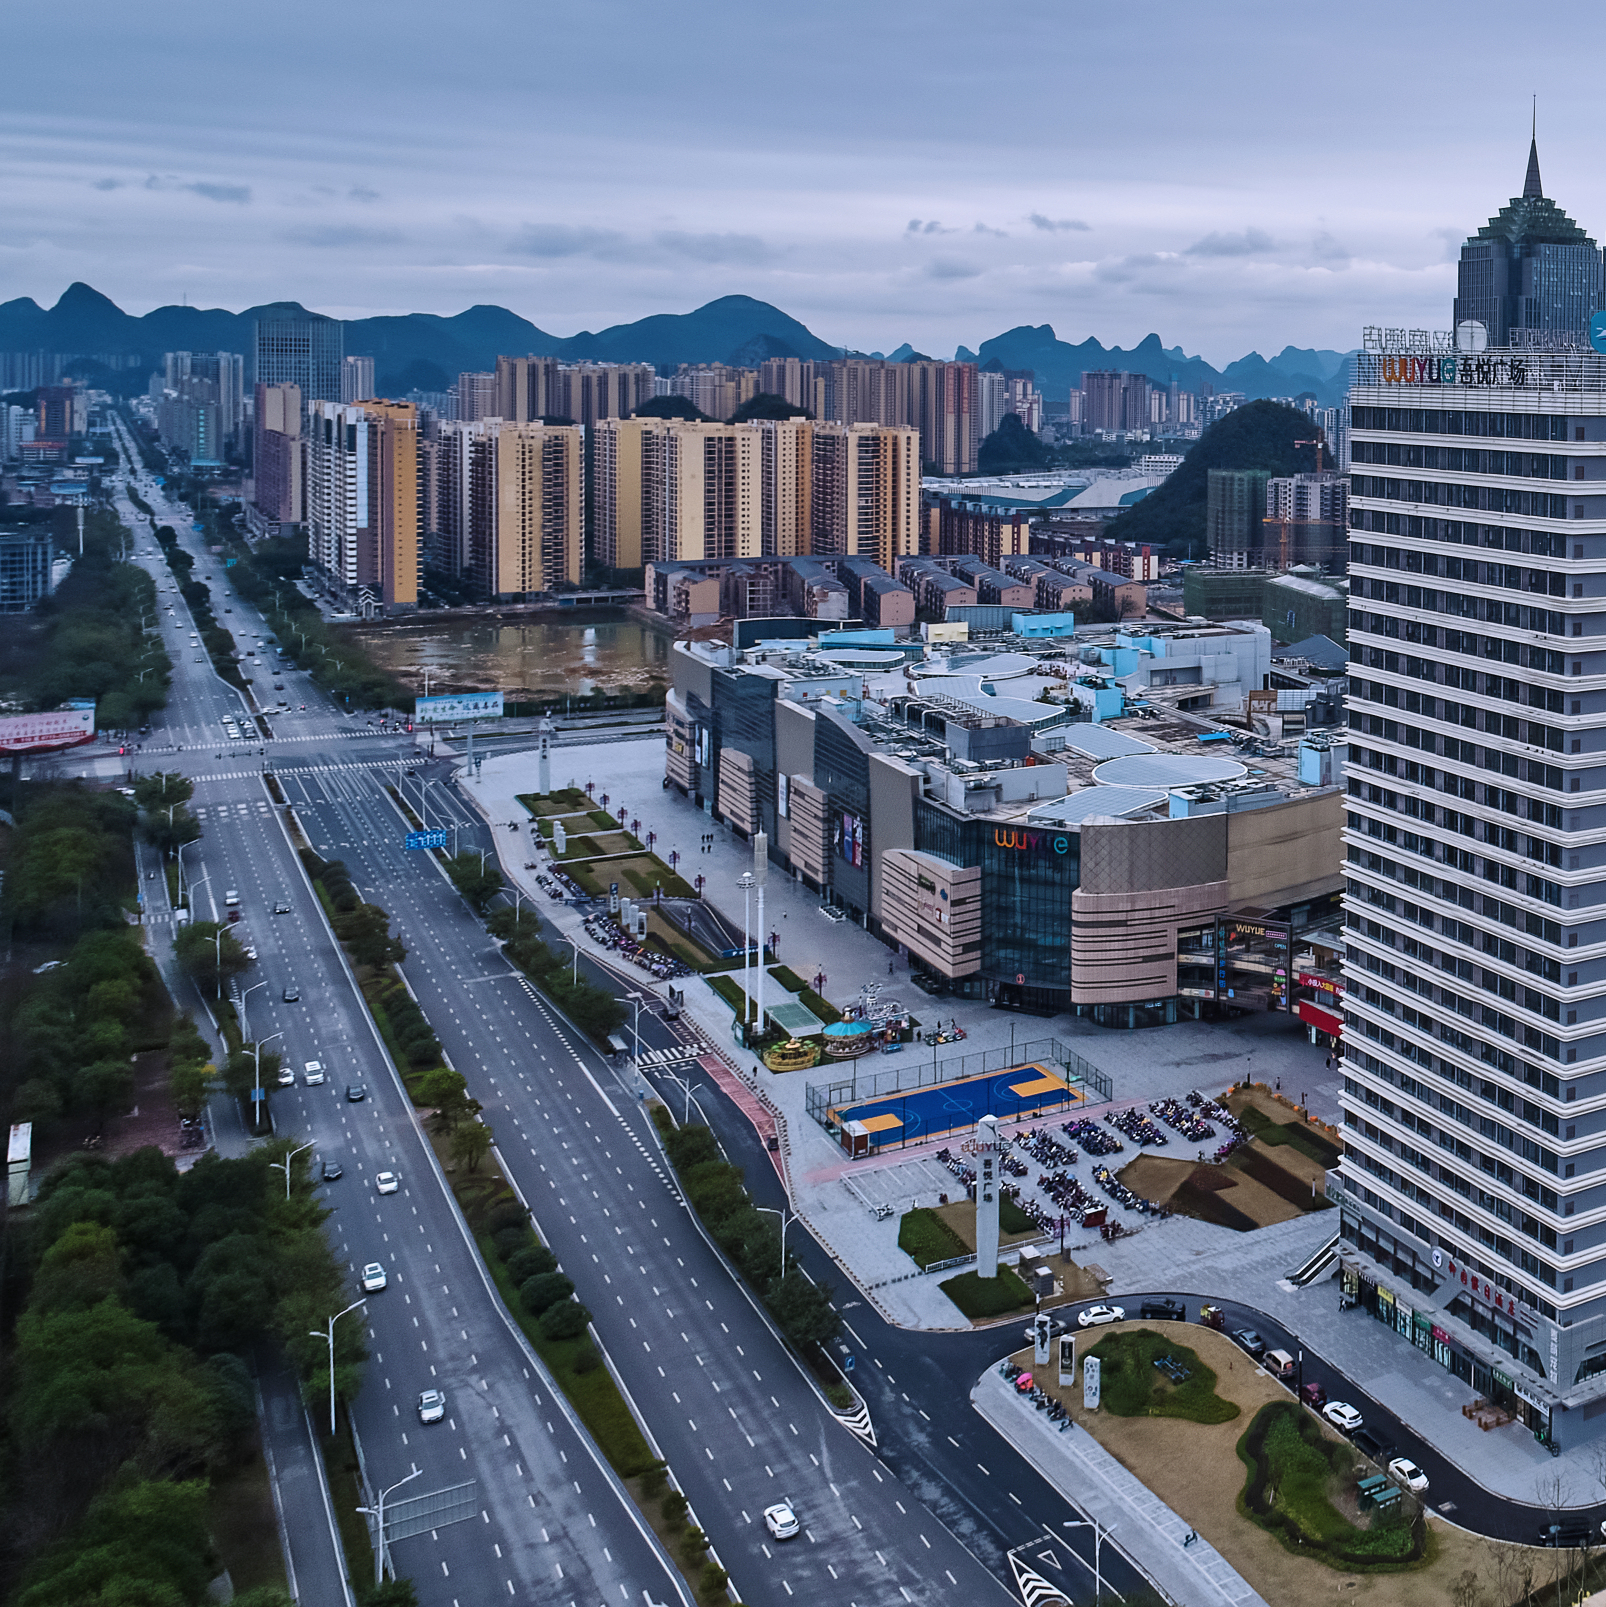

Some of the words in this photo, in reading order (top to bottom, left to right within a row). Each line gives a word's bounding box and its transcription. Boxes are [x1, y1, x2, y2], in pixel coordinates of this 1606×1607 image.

[1459, 357, 1526, 386] 吾悦广场
[982, 1158, 993, 1204] 吾悦广场
